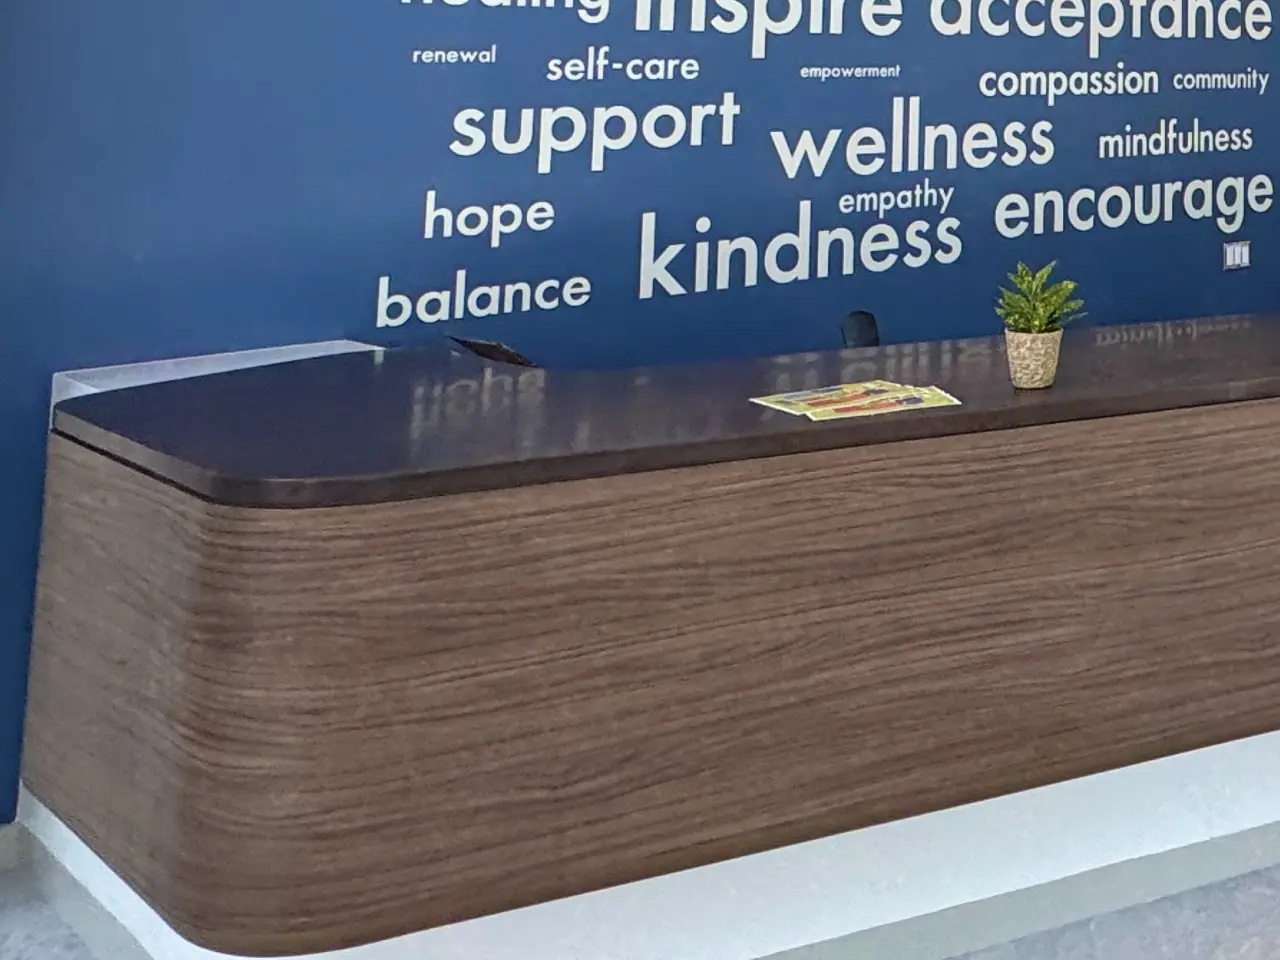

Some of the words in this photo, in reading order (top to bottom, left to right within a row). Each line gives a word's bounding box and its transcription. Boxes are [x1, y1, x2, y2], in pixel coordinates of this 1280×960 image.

[412, 43, 497, 64] renewal
[546, 45, 700, 81] self-care
[800, 65, 901, 81] empowerment
[978, 61, 1159, 107] compassion
[1173, 66, 1270, 95] community
[448, 91, 741, 174] support
[769, 95, 1055, 179] wellness
[1099, 117, 1253, 159] mindfulness
[423, 189, 555, 248] hope
[838, 177, 955, 219] empathy
[995, 174, 1274, 239] encourage
[639, 199, 962, 299] kindness
[376, 269, 591, 328] balance
